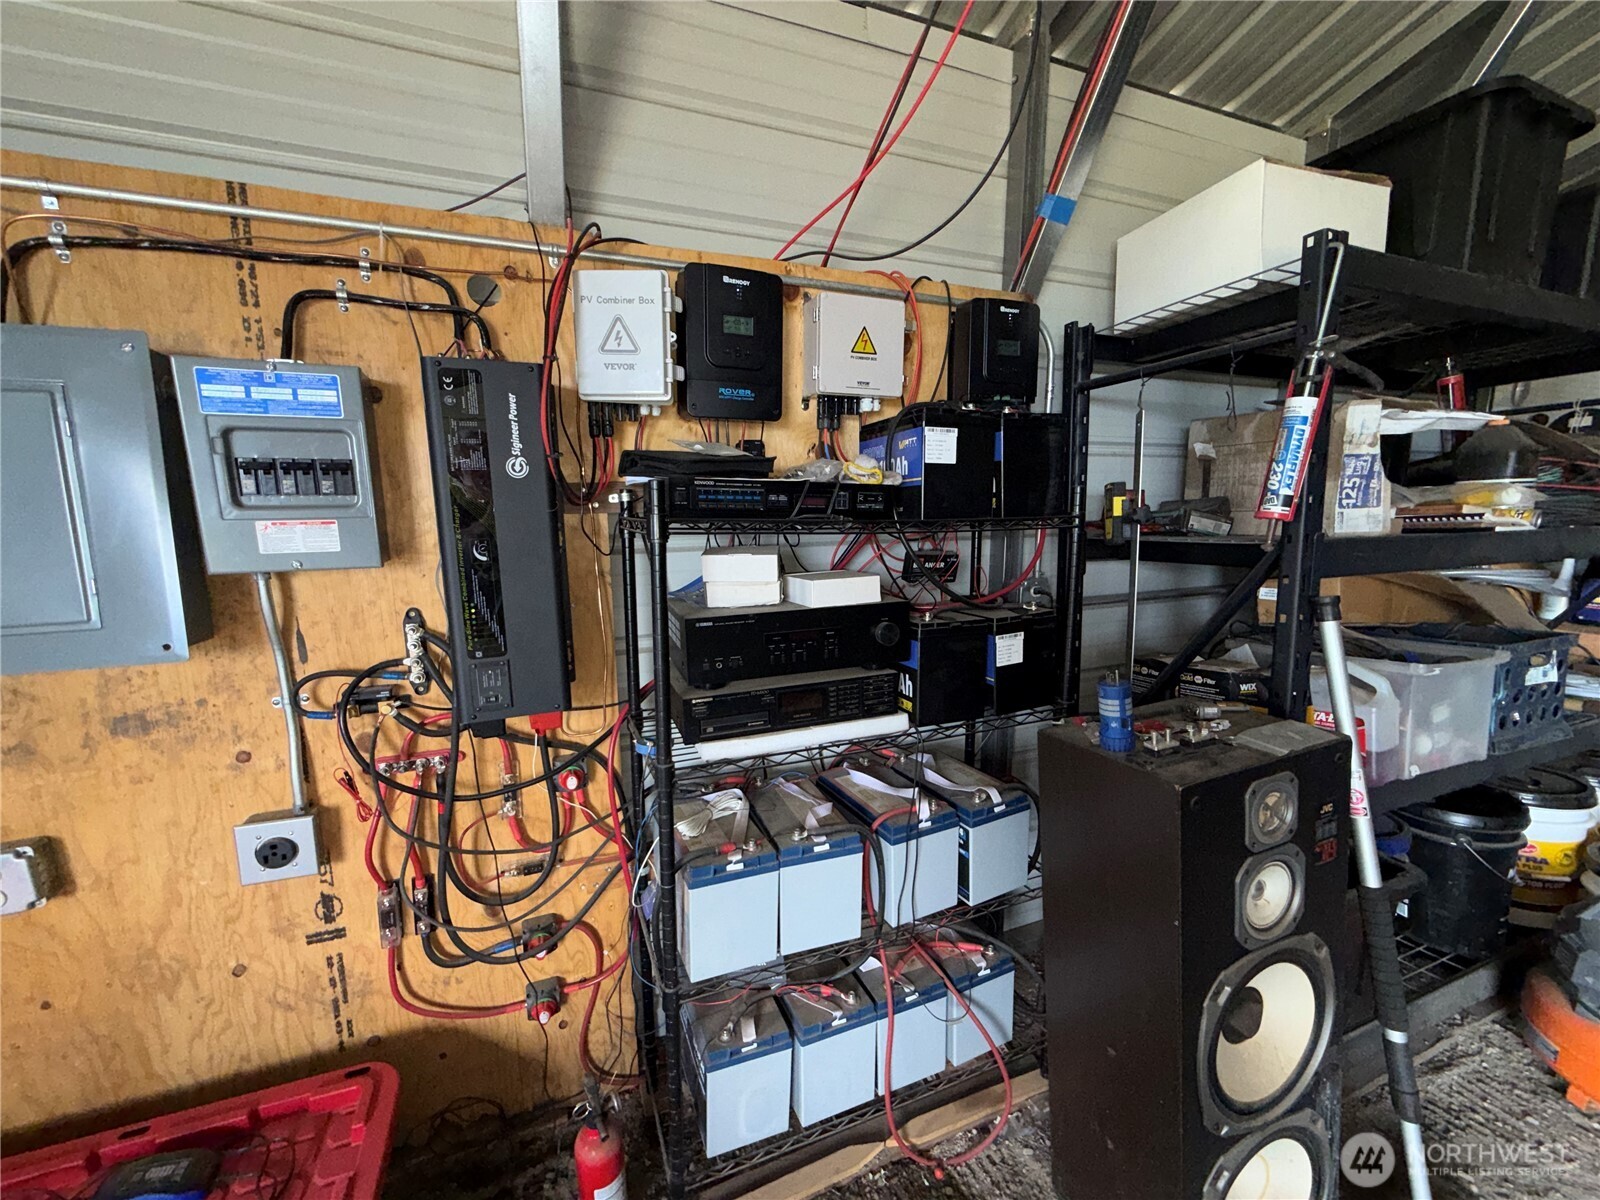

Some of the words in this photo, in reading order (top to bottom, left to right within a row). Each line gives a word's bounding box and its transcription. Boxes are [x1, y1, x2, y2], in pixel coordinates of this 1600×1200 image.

[580, 295, 593, 304] PV
[596, 296, 636, 305] Combiner
[638, 296, 656, 305] Box
[603, 362, 636, 371] VEVOR
[442, 376, 454, 391] CE
[718, 387, 752, 397] ROVER
[508, 392, 518, 421] Power
[510, 421, 523, 456] Sigineer
[1282, 427, 1306, 492] DYNAFLEX
[1267, 461, 1284, 490] 230
[1341, 477, 1361, 508] 125
[453, 504, 461, 534] Charger
[456, 541, 465, 567] Inverter
[459, 567, 469, 601] Combined
[462, 602, 471, 620] Wave
[1240, 682, 1257, 691] WIX
[1320, 803, 1333, 814] JVC
[1517, 855, 1550, 865] TRA
